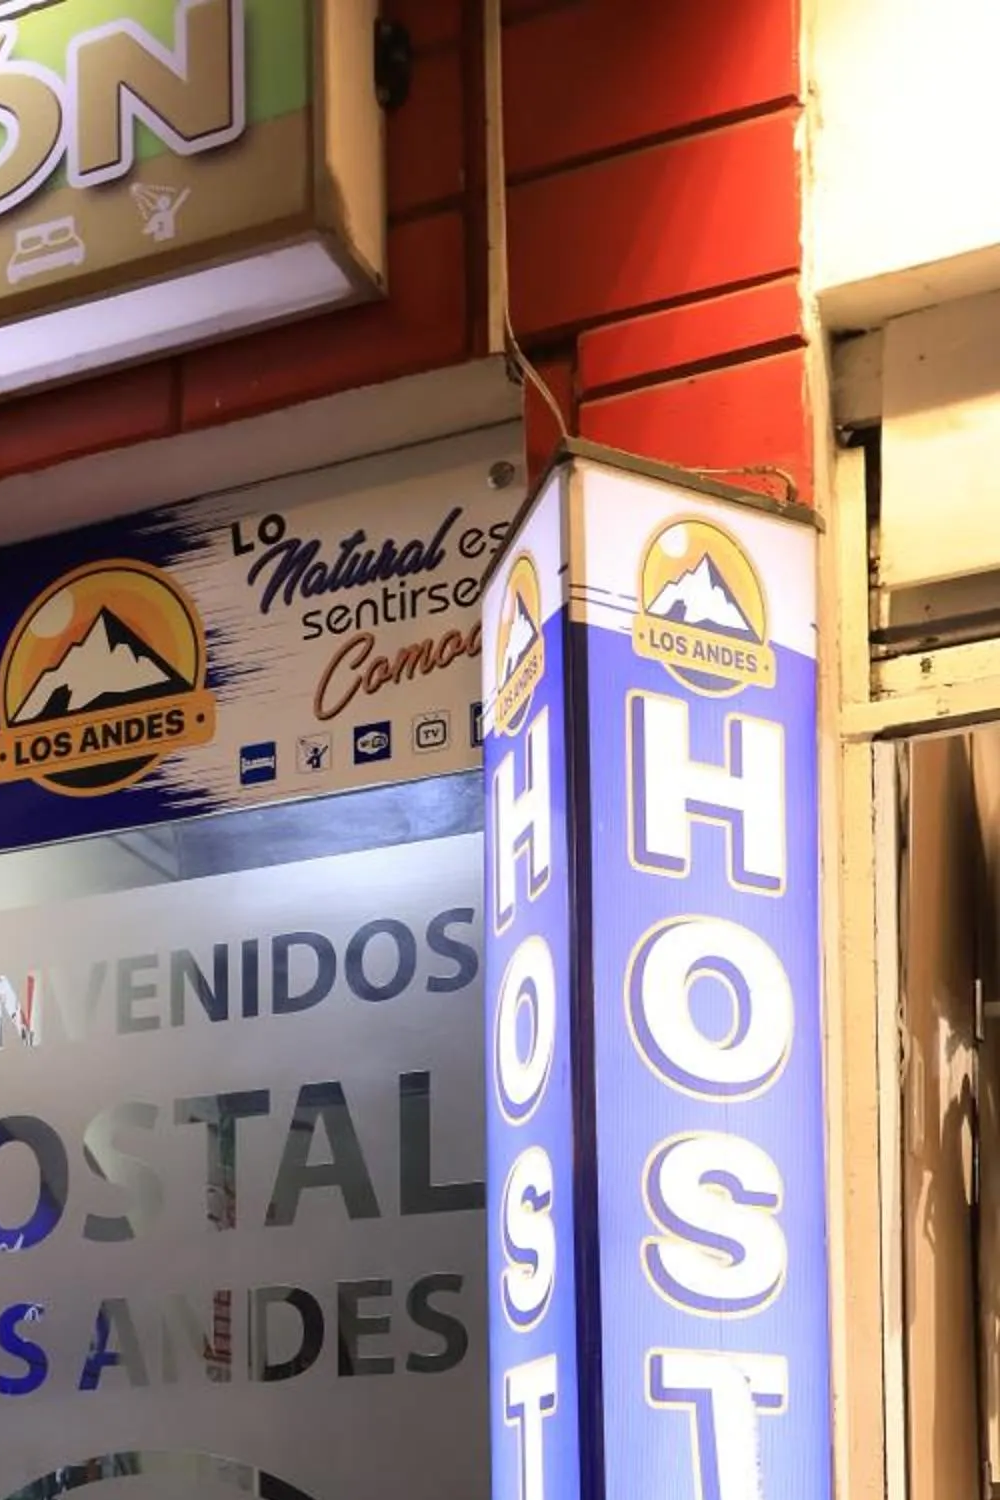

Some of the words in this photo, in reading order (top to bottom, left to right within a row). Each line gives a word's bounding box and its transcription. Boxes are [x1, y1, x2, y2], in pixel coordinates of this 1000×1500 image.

[230, 513, 286, 556] LO
[247, 507, 463, 614] Natural
[302, 576, 482, 640] sentirse
[649, 628, 688, 656] LOS
[692, 640, 758, 673] ANDES
[14, 729, 69, 766] LOS
[79, 711, 186, 756] ANDES
[78, 1272, 469, 1390] ANDES
